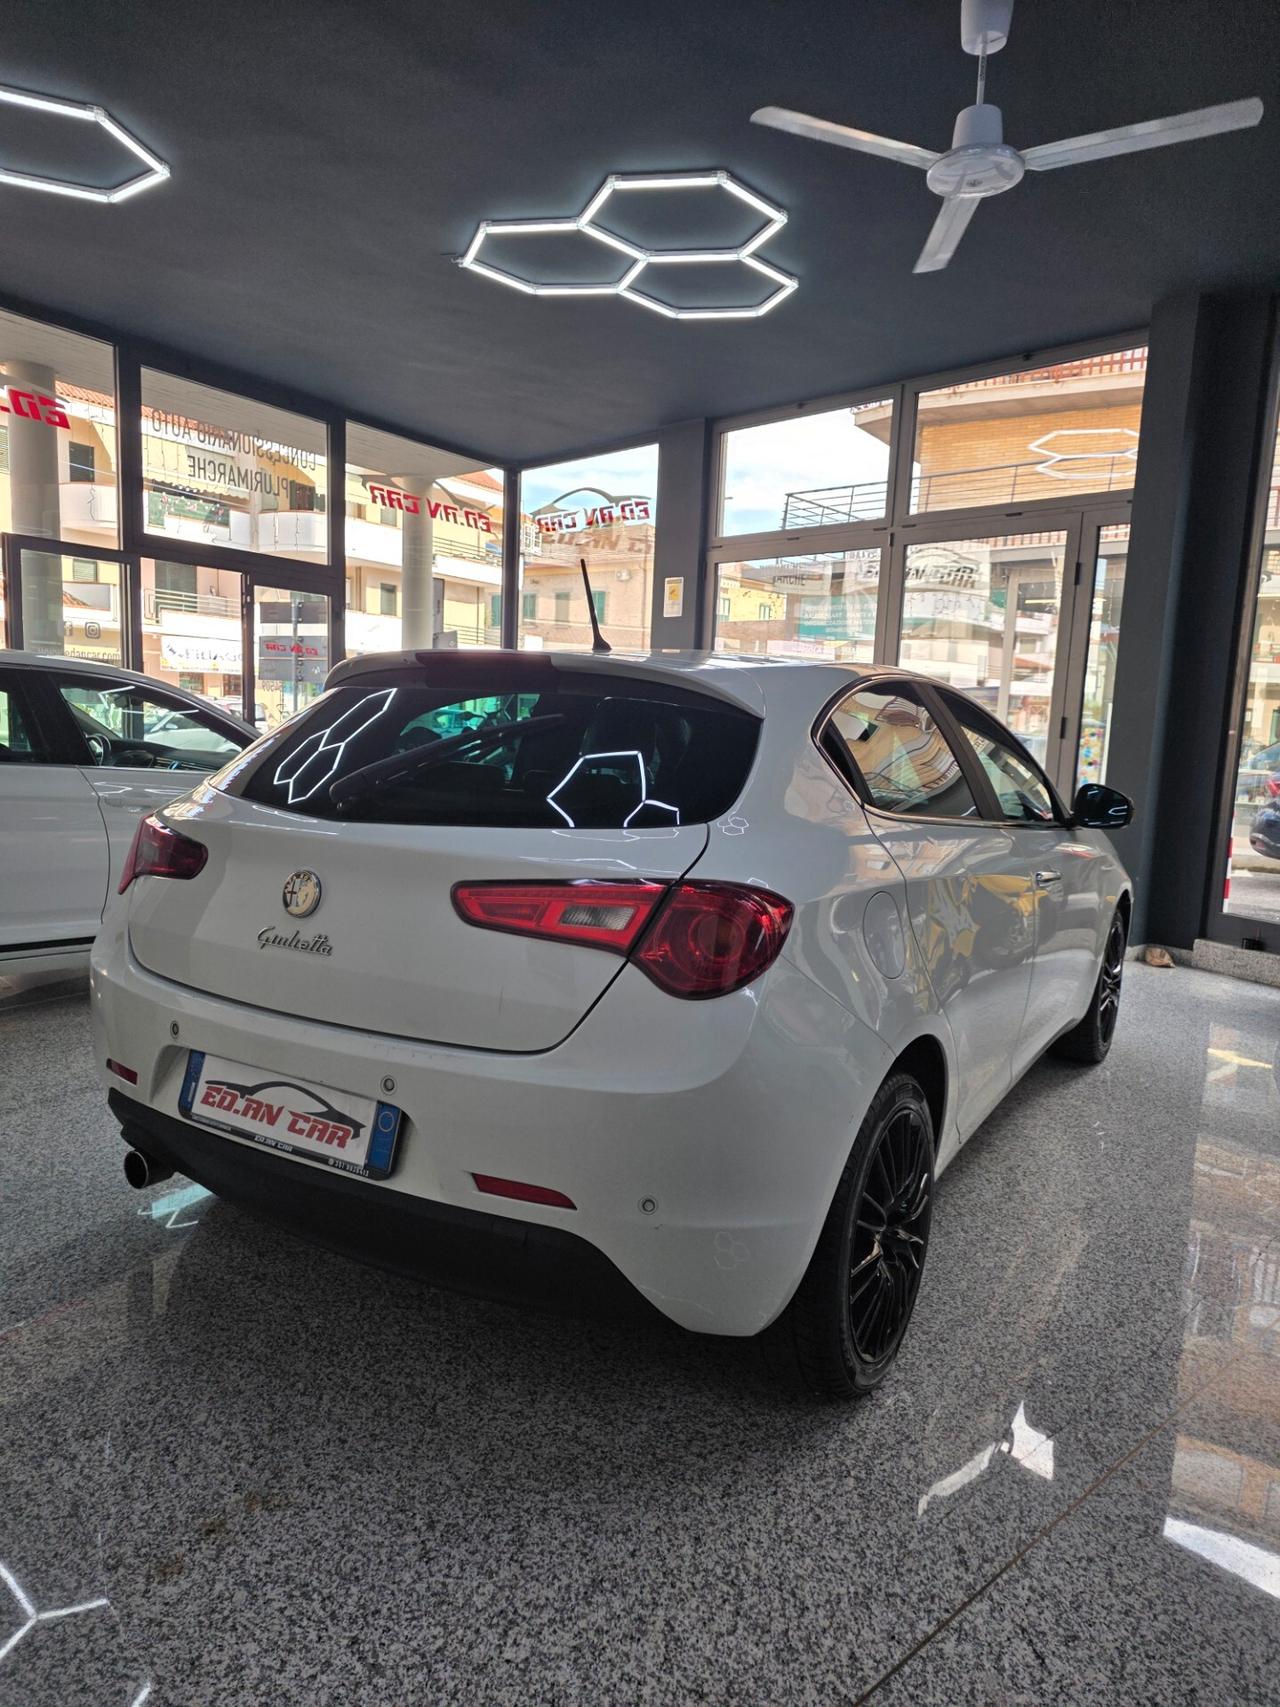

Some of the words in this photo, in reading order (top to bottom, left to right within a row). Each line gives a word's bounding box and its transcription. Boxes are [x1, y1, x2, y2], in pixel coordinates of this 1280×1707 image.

[257, 926, 332, 956] Giulietta
[200, 1085, 285, 1127] ED.AN
[287, 1110, 354, 1149] CAR
